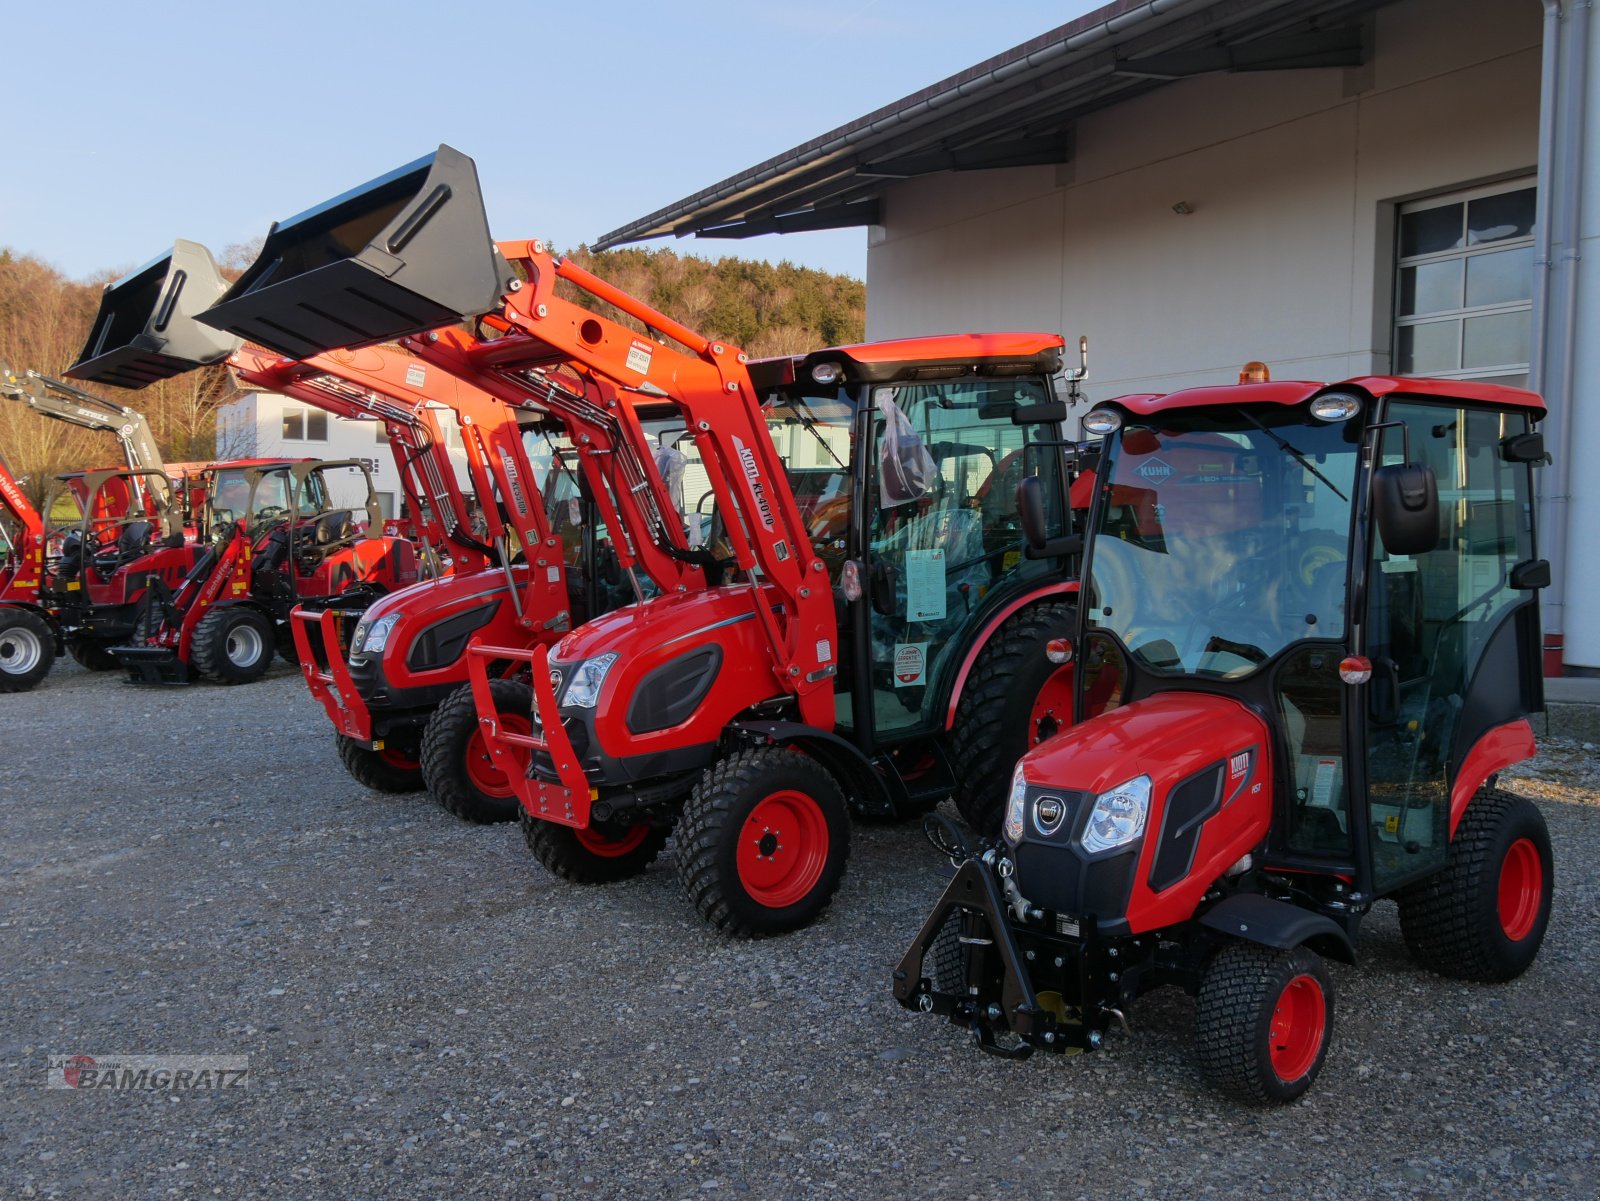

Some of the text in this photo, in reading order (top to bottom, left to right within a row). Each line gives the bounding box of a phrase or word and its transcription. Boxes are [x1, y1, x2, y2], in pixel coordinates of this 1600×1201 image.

[503, 456, 518, 480] KIOTI
[740, 448, 760, 479] KIOTI
[1141, 466, 1170, 476] KUHN
[1231, 752, 1249, 774] KIOTI
